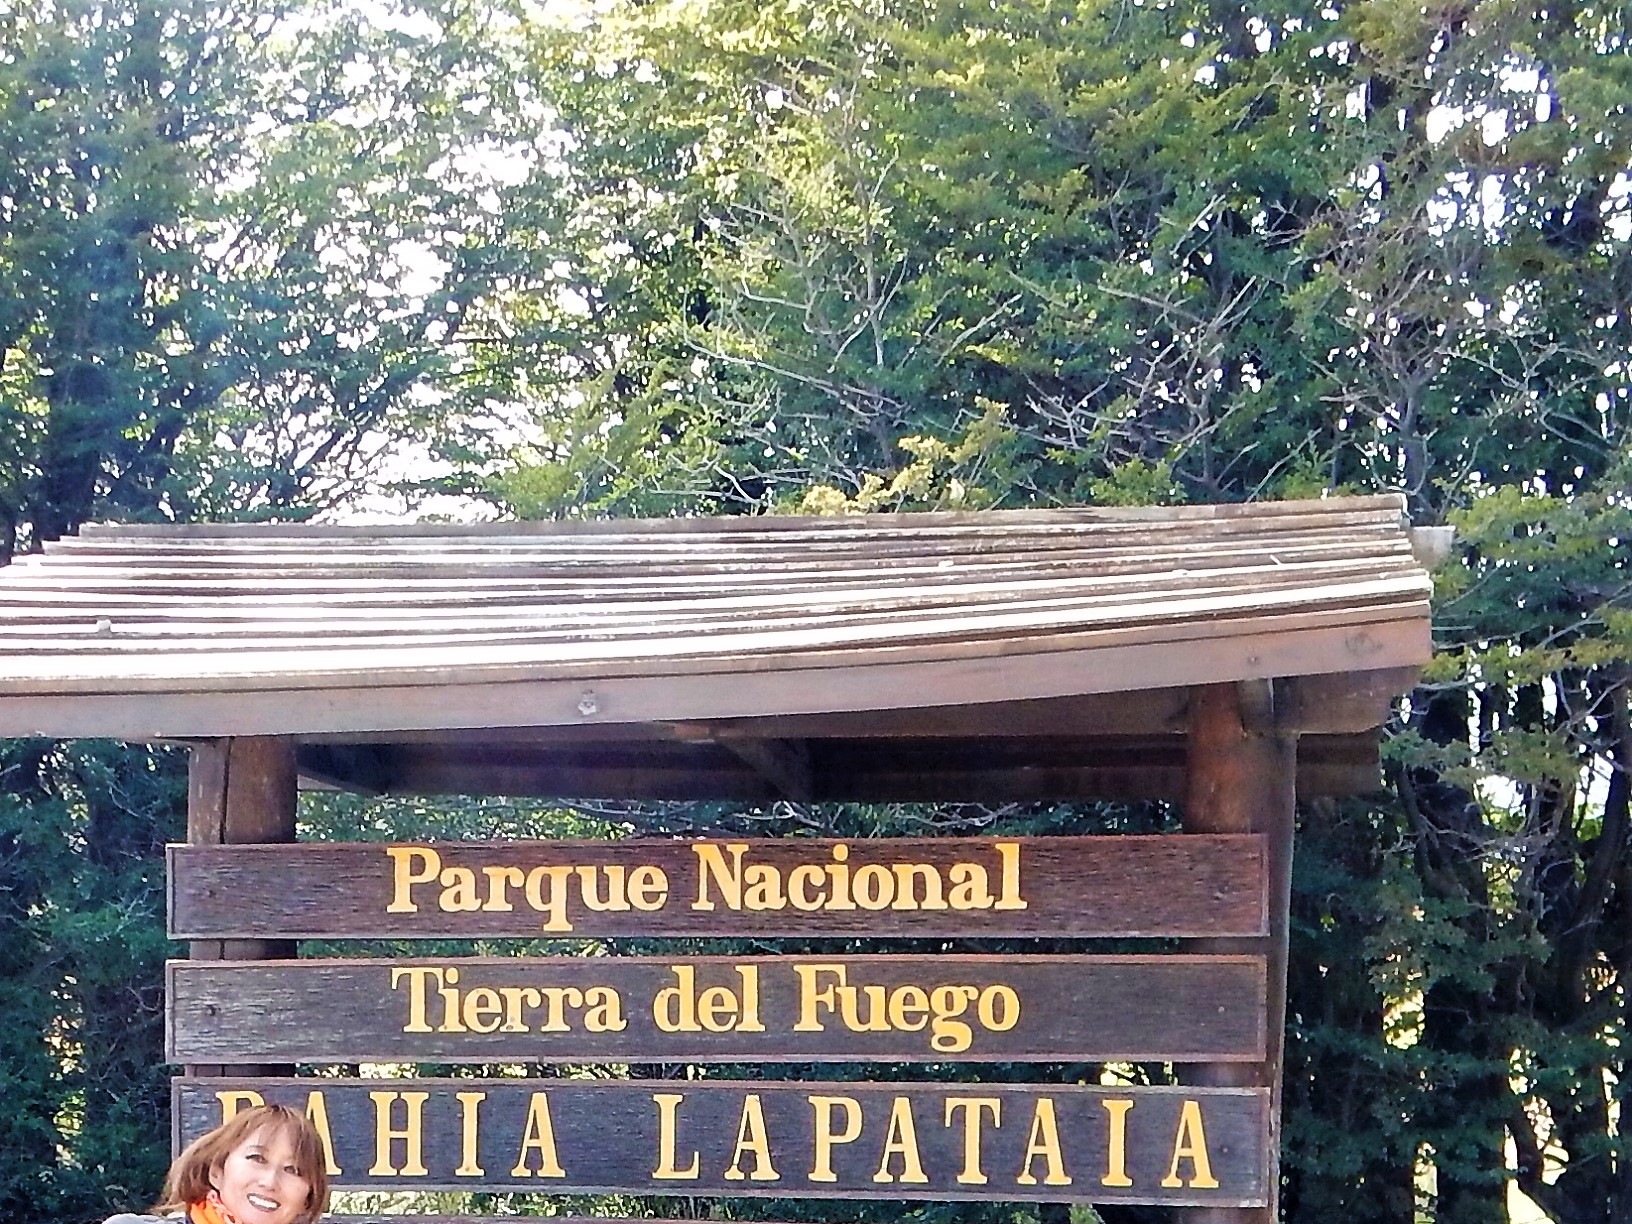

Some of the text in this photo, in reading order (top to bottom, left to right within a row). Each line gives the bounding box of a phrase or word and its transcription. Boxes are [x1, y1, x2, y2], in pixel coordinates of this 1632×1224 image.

[386, 843, 1028, 932] Parque Nacional
[391, 963, 1020, 1053] Tierra del Fuego
[651, 1093, 1220, 1189] LAPATAIA
